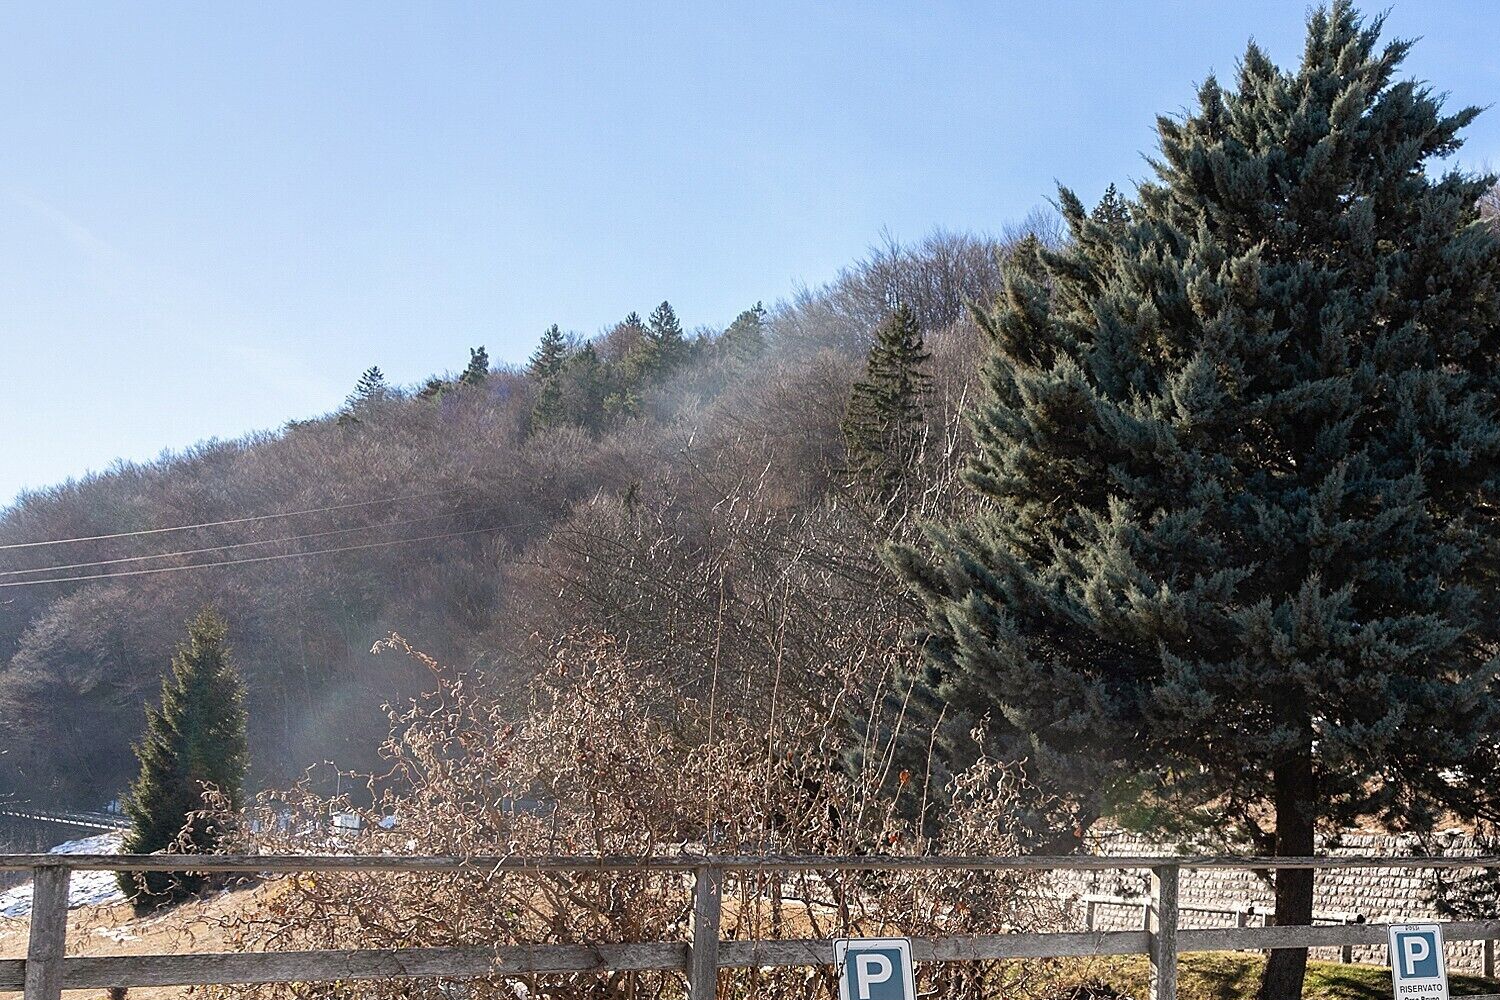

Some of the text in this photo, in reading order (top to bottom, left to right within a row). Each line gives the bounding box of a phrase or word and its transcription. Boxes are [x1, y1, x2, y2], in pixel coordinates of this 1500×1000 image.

[1404, 936, 1430, 974] P
[856, 954, 893, 999] P
[1400, 984, 1442, 994] RISERVATO
